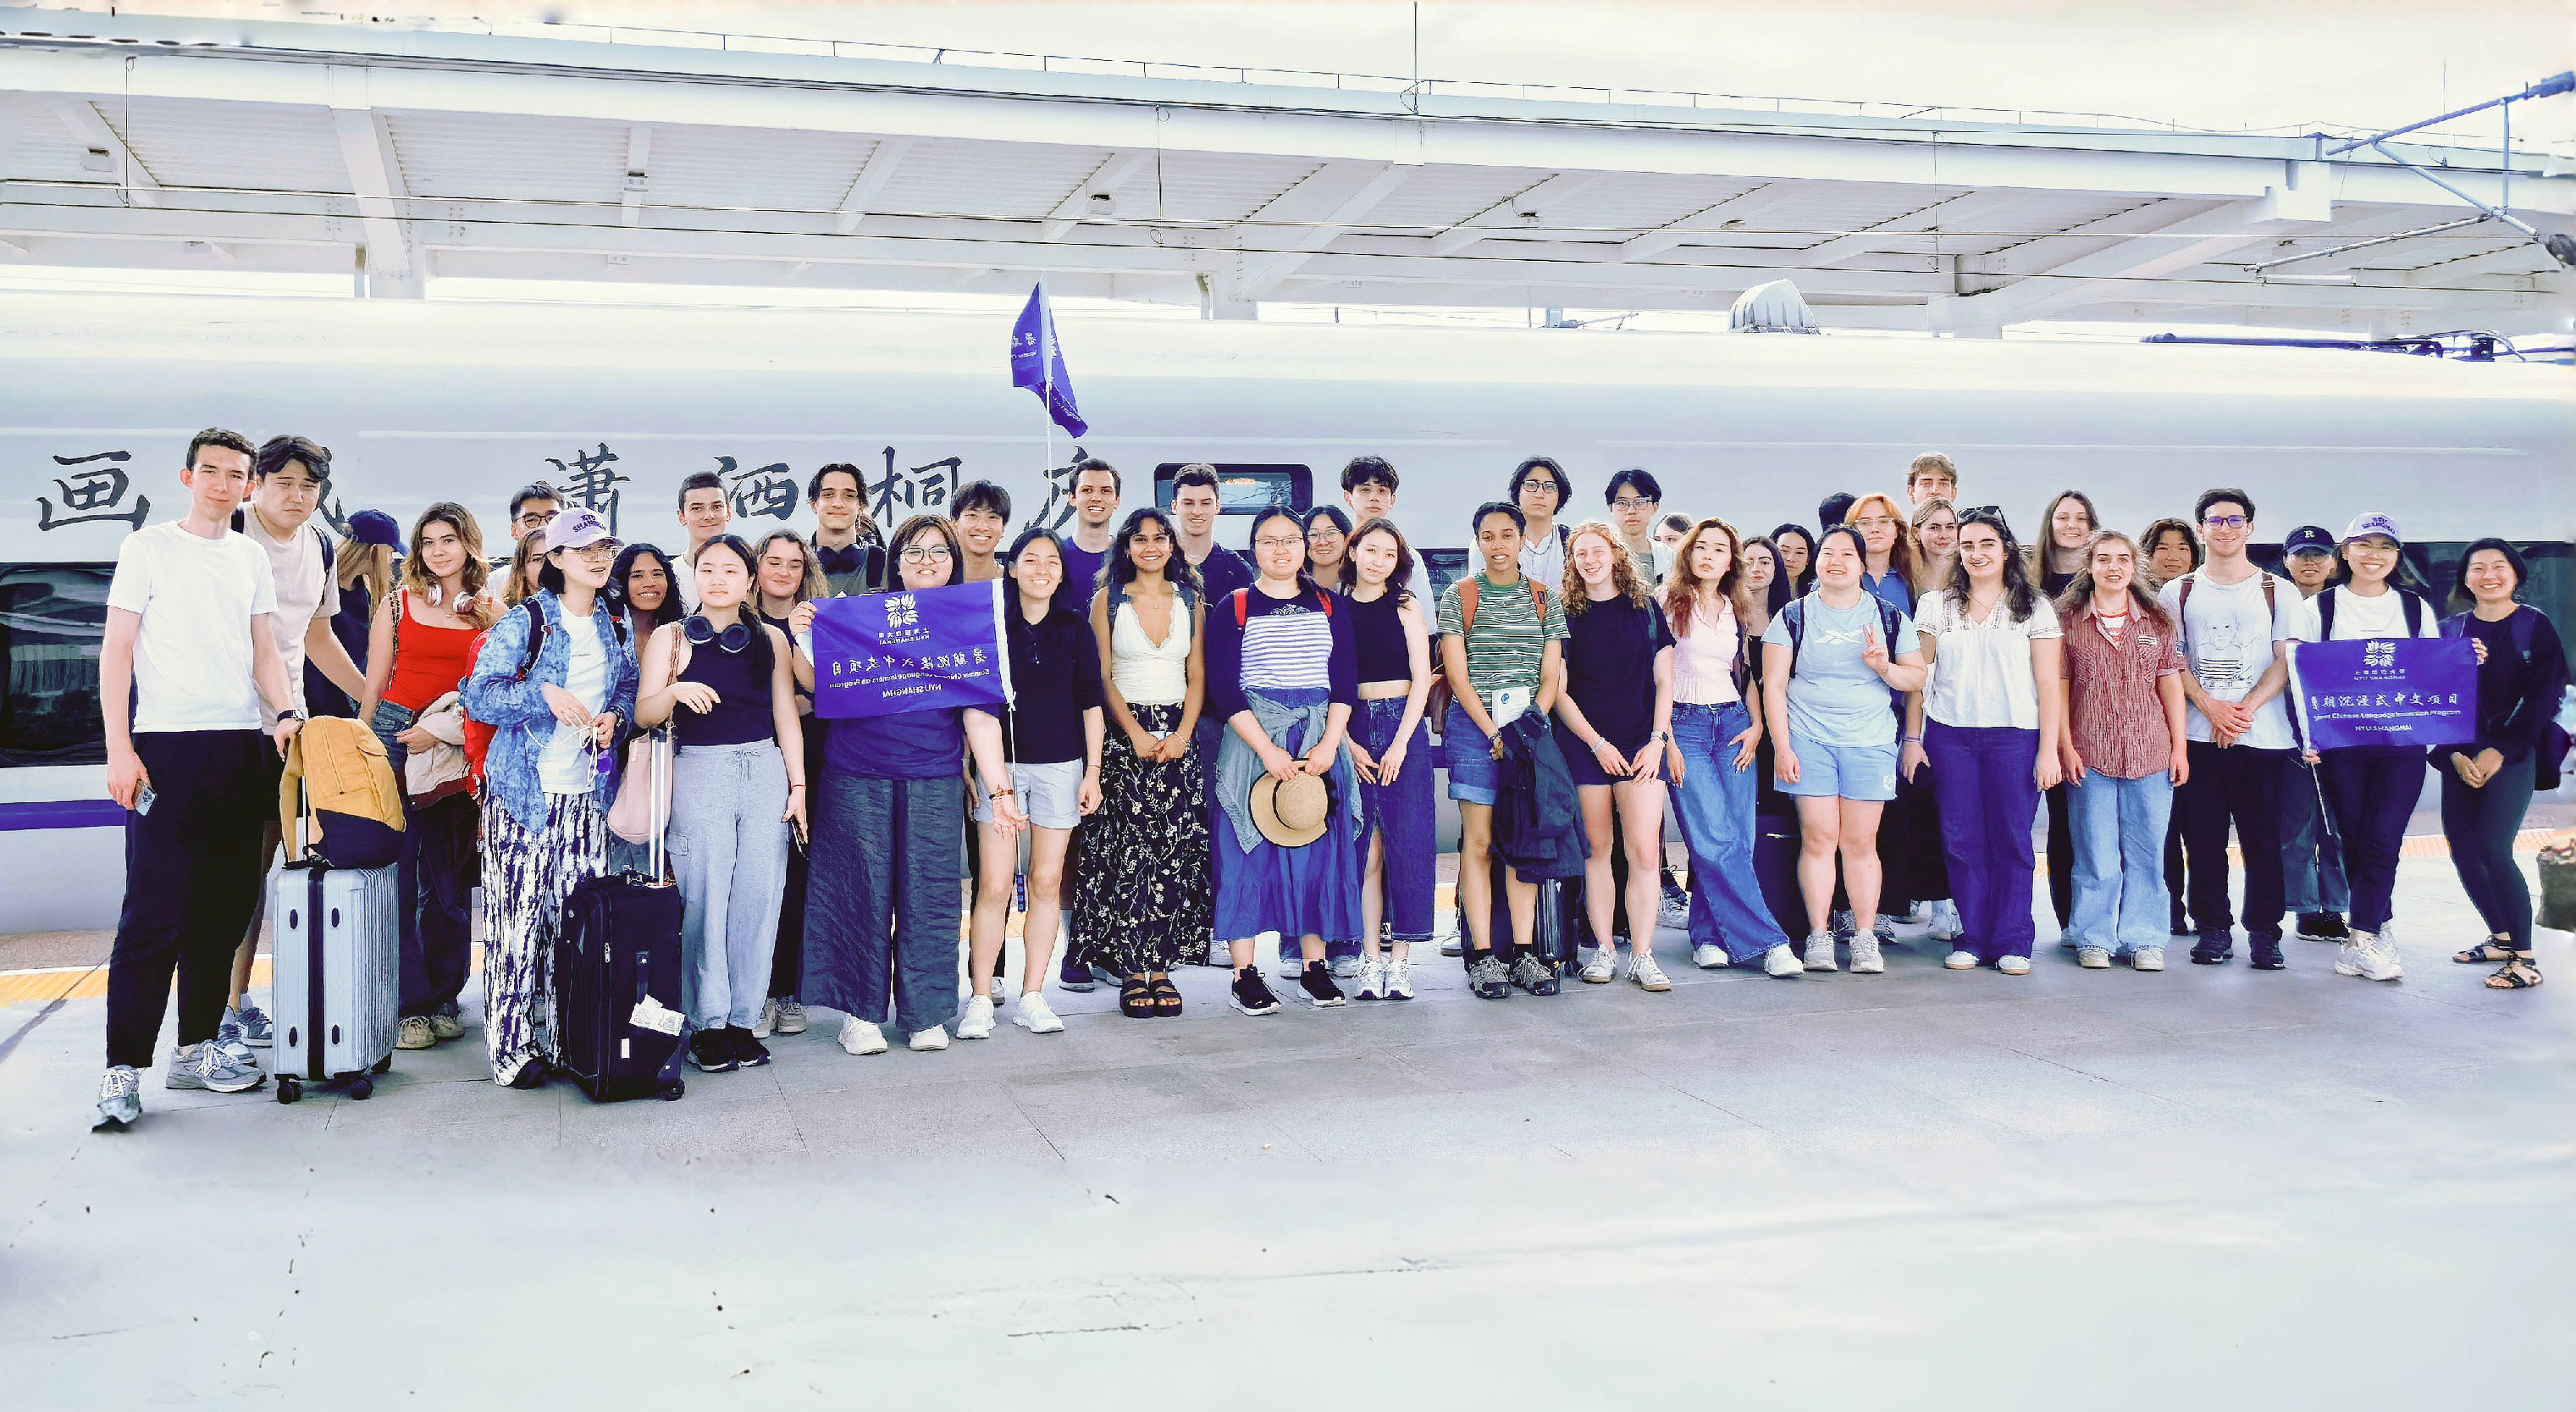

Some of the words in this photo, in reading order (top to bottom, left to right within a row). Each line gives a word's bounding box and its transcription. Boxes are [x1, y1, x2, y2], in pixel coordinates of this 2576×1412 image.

[2303, 530, 2316, 539] R
[2360, 711, 2395, 720] Language
[2372, 723, 2413, 732] SHANGHAI
